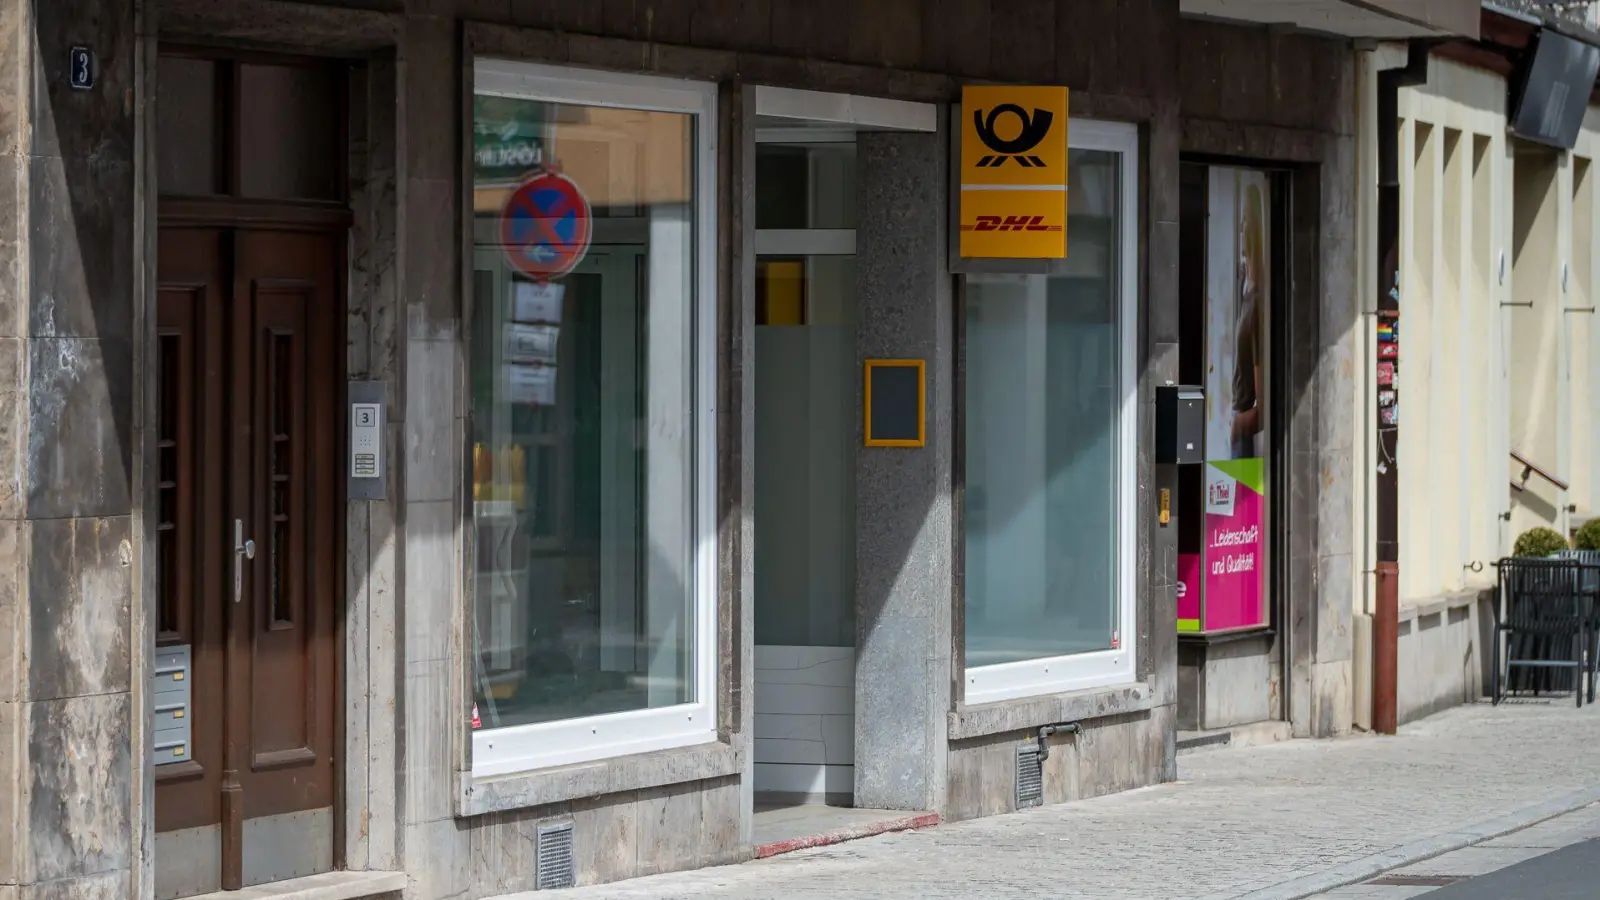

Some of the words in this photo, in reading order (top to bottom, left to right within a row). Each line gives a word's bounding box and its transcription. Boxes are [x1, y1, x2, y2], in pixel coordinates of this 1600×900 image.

[79, 52, 89, 83] 3
[972, 215, 1050, 232] DHL
[361, 412, 369, 424] 3
[1216, 484, 1230, 500] Thiel
[1211, 555, 1225, 575] und
